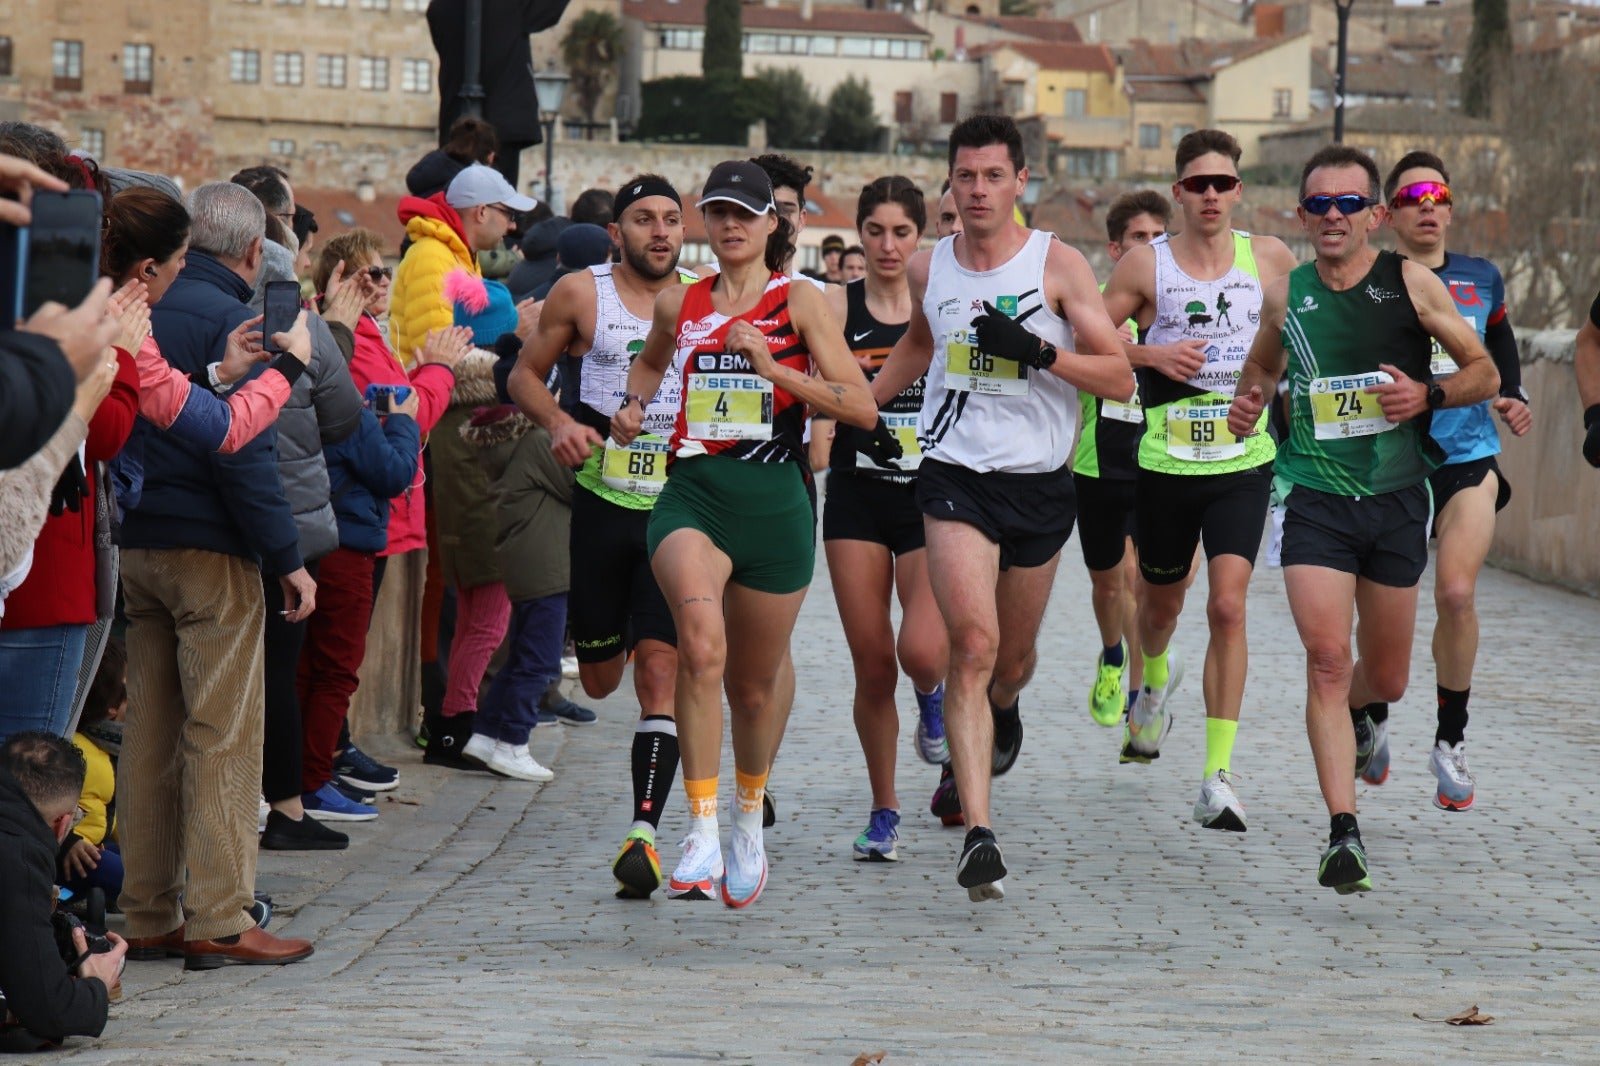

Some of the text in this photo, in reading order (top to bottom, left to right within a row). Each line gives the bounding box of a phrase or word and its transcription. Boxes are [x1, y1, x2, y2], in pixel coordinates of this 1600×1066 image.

[1182, 327, 1191, 336] La
[720, 354, 751, 370] BM
[707, 377, 764, 390] SETEL
[1330, 375, 1386, 391] SETEL
[715, 391, 728, 417] 4
[1334, 391, 1363, 417] 24
[646, 413, 675, 422] AXIM
[1189, 408, 1228, 419] SETE
[1190, 421, 1214, 442] 69
[629, 441, 672, 452] SETE
[628, 451, 655, 476] 68
